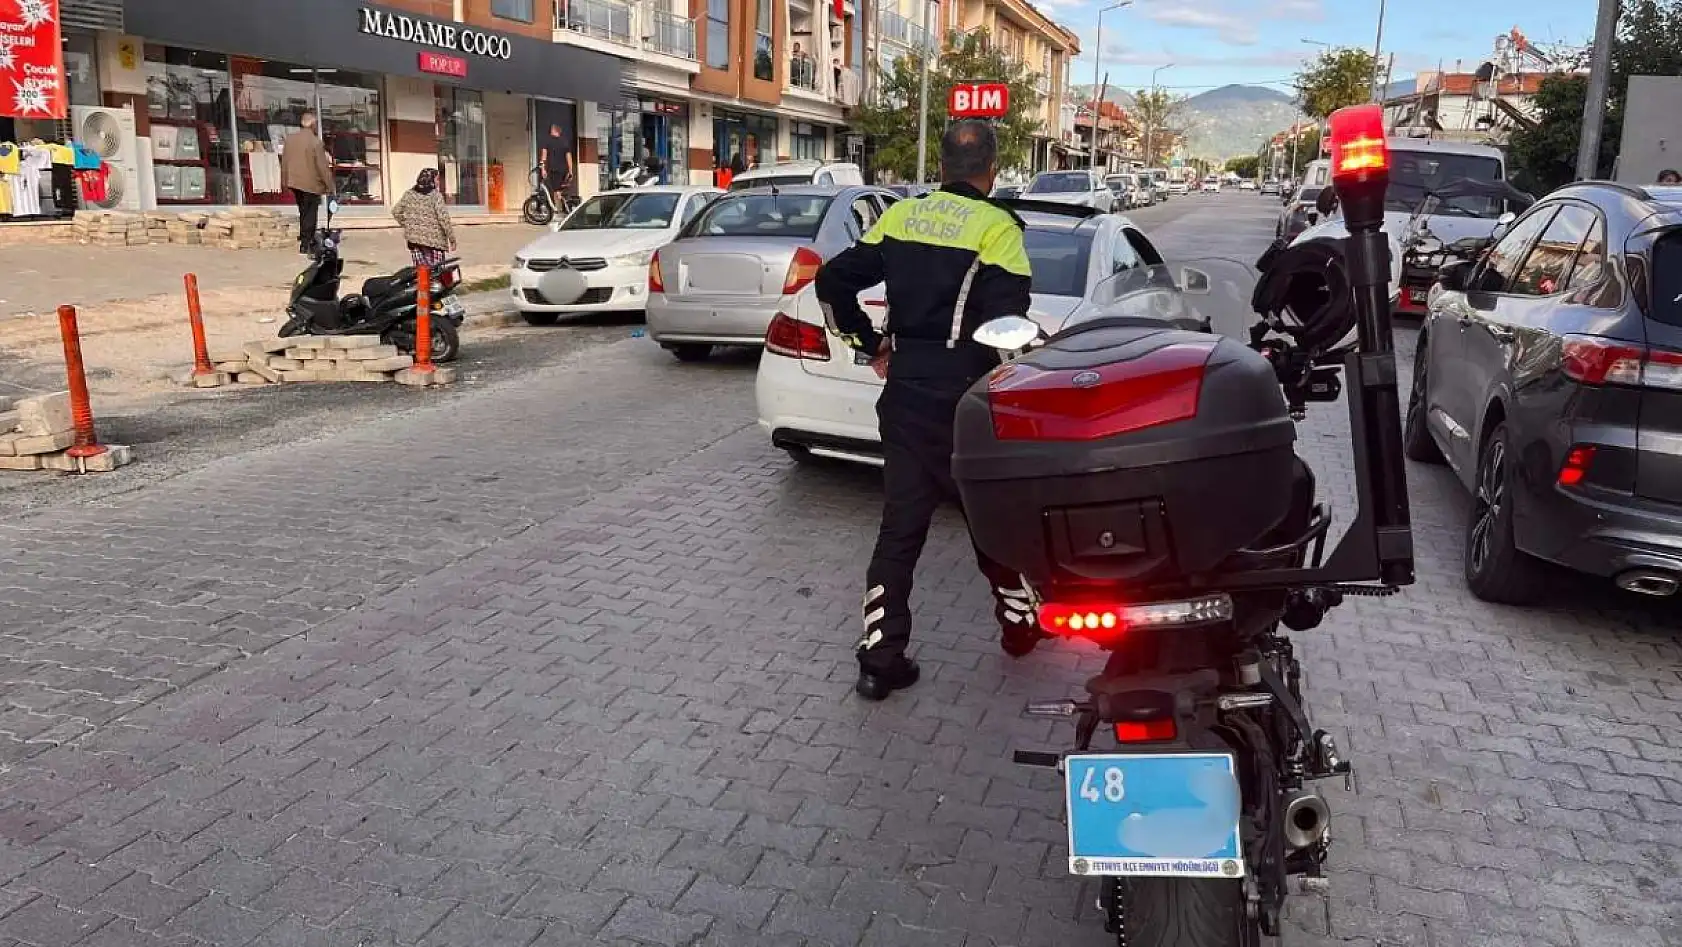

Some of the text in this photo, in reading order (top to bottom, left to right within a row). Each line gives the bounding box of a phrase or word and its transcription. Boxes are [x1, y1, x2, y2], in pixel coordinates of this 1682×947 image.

[362, 7, 511, 59] MADAME COCO
[954, 85, 1001, 111] BİM
[1080, 767, 1124, 802] 48
